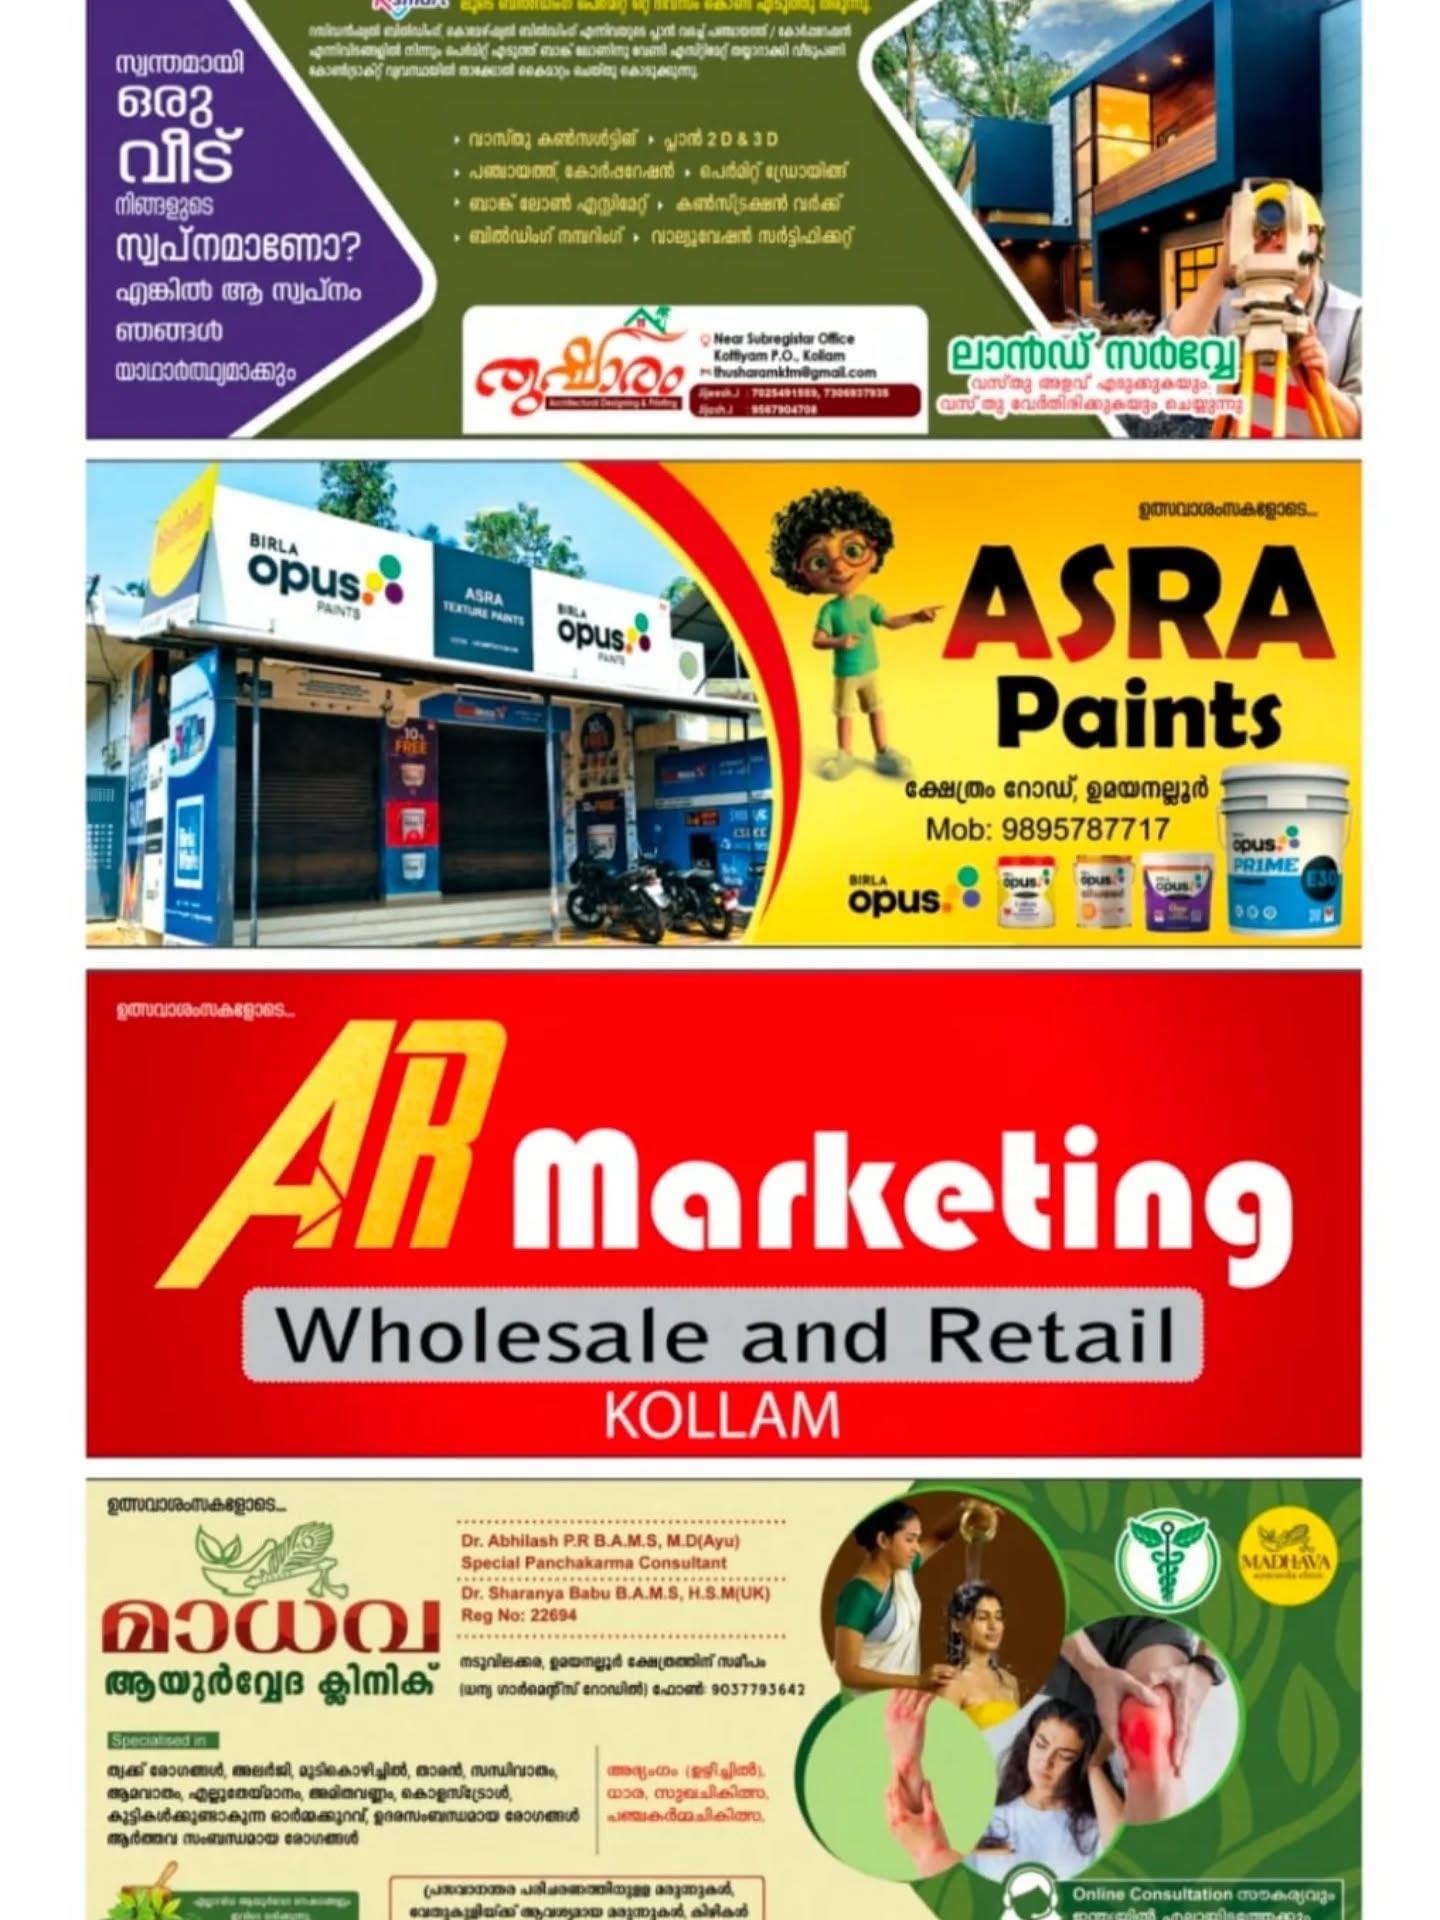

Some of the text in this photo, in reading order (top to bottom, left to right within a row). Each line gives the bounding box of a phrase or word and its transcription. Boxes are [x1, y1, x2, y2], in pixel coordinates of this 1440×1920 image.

[116, 50, 244, 74] സ്വന്തമായി
[118, 85, 213, 128] ഒരു
[119, 127, 243, 184] വീട്
[116, 192, 213, 220] നിങ്ങളുടെ
[116, 278, 361, 305] എങ്കിൽ ആ സ്വപ്നം
[116, 320, 222, 342] ഞങ്ങൾ
[714, 332, 743, 345] Near
[818, 332, 855, 345] Office
[714, 350, 767, 364] Kottiyam
[803, 350, 845, 363] Kollam
[951, 333, 1096, 372] ലാൻഡ്
[250, 533, 298, 556] BIRLA
[248, 554, 361, 602] opus
[465, 587, 504, 607] ASRA
[941, 543, 1337, 663] ASRA
[317, 601, 361, 620] PAINTS
[443, 600, 525, 627] TEXTURE PAINTS
[557, 603, 587, 619] BIRLA
[557, 619, 625, 651] opus
[997, 675, 1283, 749] Paints
[905, 778, 995, 803] ക്ഷേത്രം
[926, 817, 1170, 842] Mob: 9895787717
[1234, 857, 1300, 872] PRIME
[849, 874, 888, 886] BIRLA
[848, 890, 941, 918] opus
[154, 1019, 1294, 1289] AR Marketing
[275, 1306, 1173, 1364] Wholesale and Retail
[605, 1391, 840, 1439] KOLLAM
[461, 1533, 740, 1550] Dr. Abhilash P.R B.A.M.S, M.D(Ayu)
[461, 1556, 727, 1572] Special Panchakarma Consultant
[1242, 1553, 1331, 1570] MADHAVA
[461, 1586, 771, 1603] Dr. Sharanya Babu B.A.M.S, H.S.M(UK)
[102, 1599, 441, 1654] മാധവ
[461, 1608, 577, 1625] Reg No: 22694
[318, 1662, 441, 1706] ക്ലിനിക്
[711, 1683, 805, 1697] 9037793642
[112, 1733, 207, 1748] Specialised in
[1072, 1887, 1126, 1901] Online
[1129, 1887, 1233, 1901] Consultation
